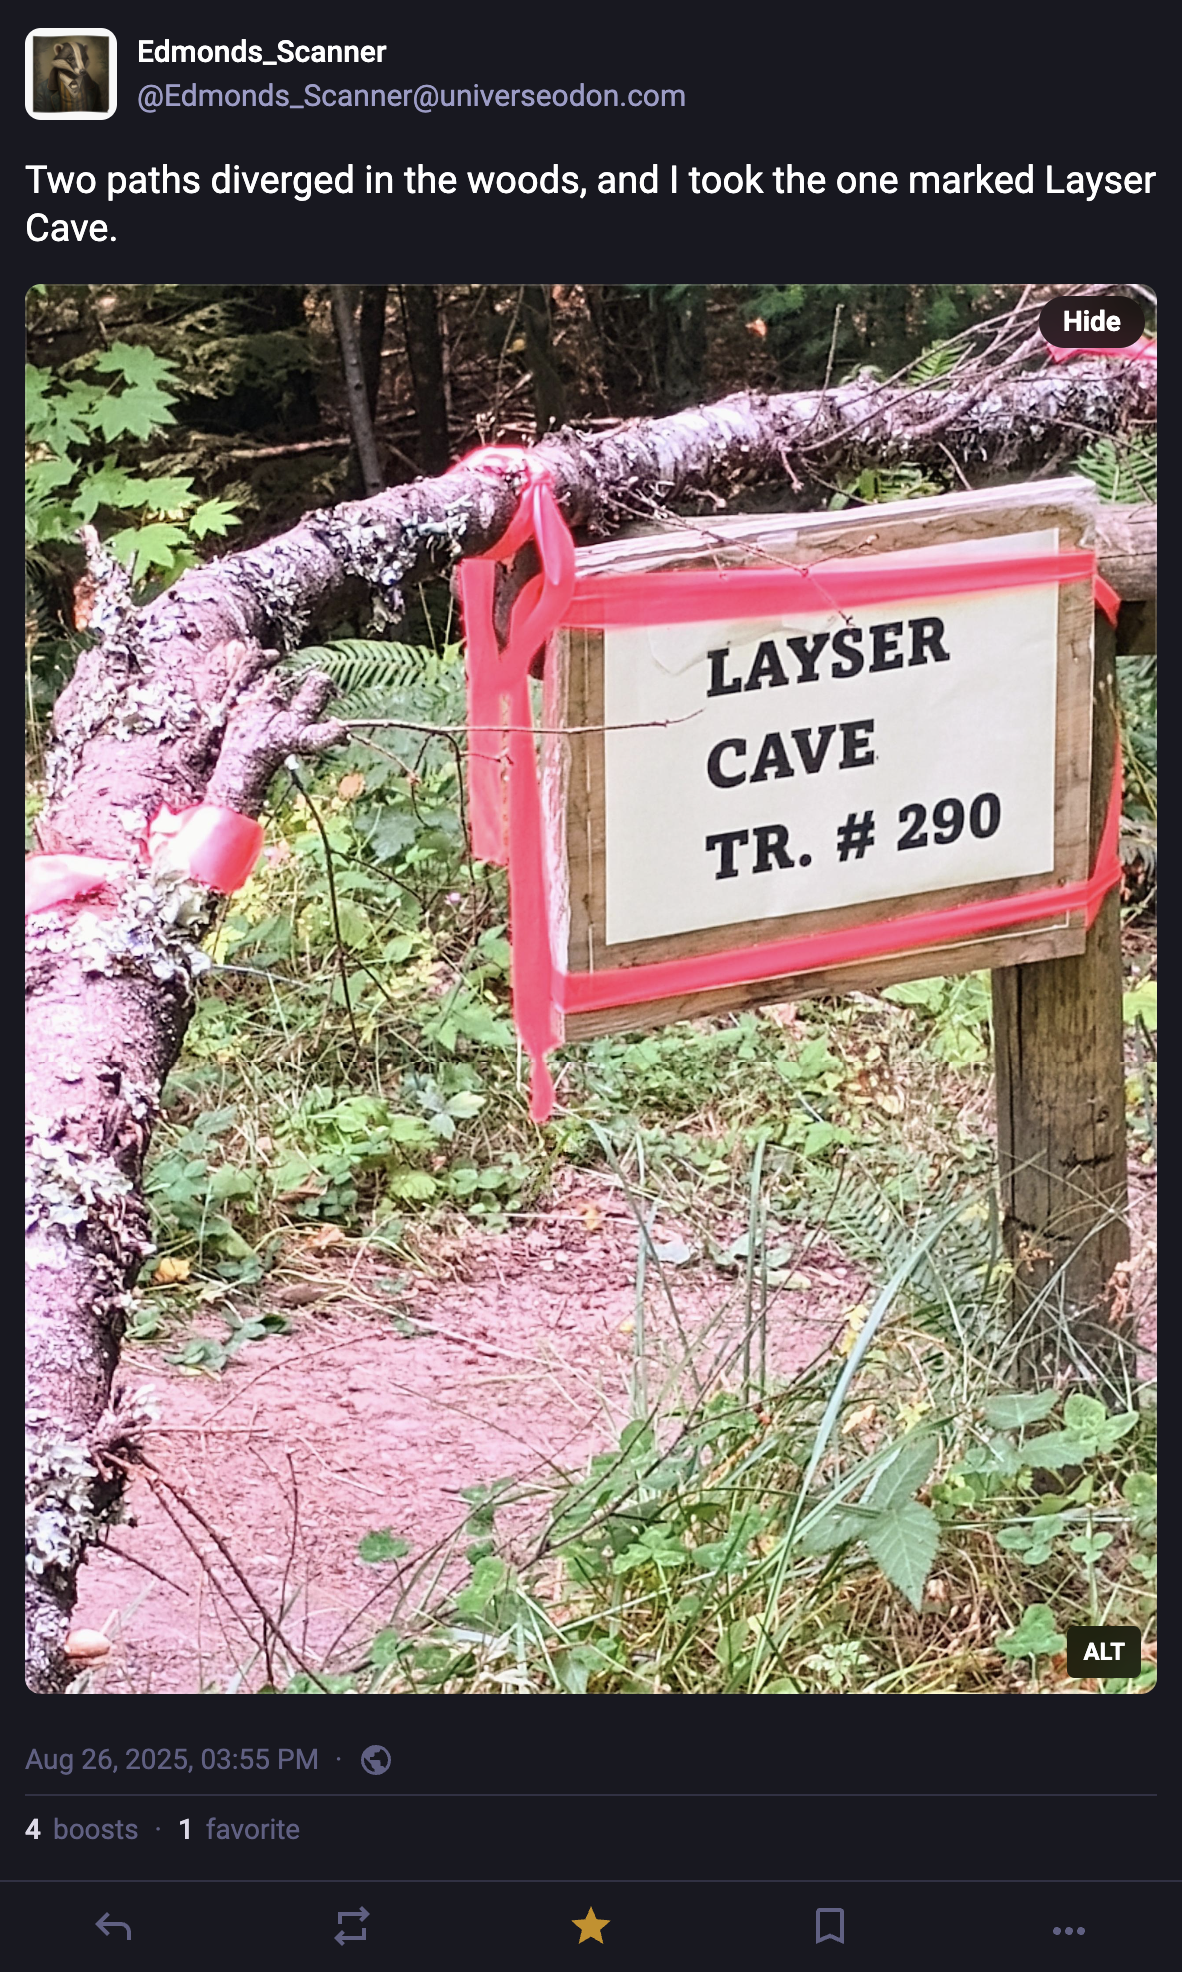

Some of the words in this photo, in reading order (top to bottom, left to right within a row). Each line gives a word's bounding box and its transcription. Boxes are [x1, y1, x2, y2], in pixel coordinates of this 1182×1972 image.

[706, 616, 950, 697] LAYSER
[707, 719, 875, 789] CAVE
[705, 824, 813, 880] TR.
[837, 811, 875, 862] #
[896, 792, 1002, 852] 290
